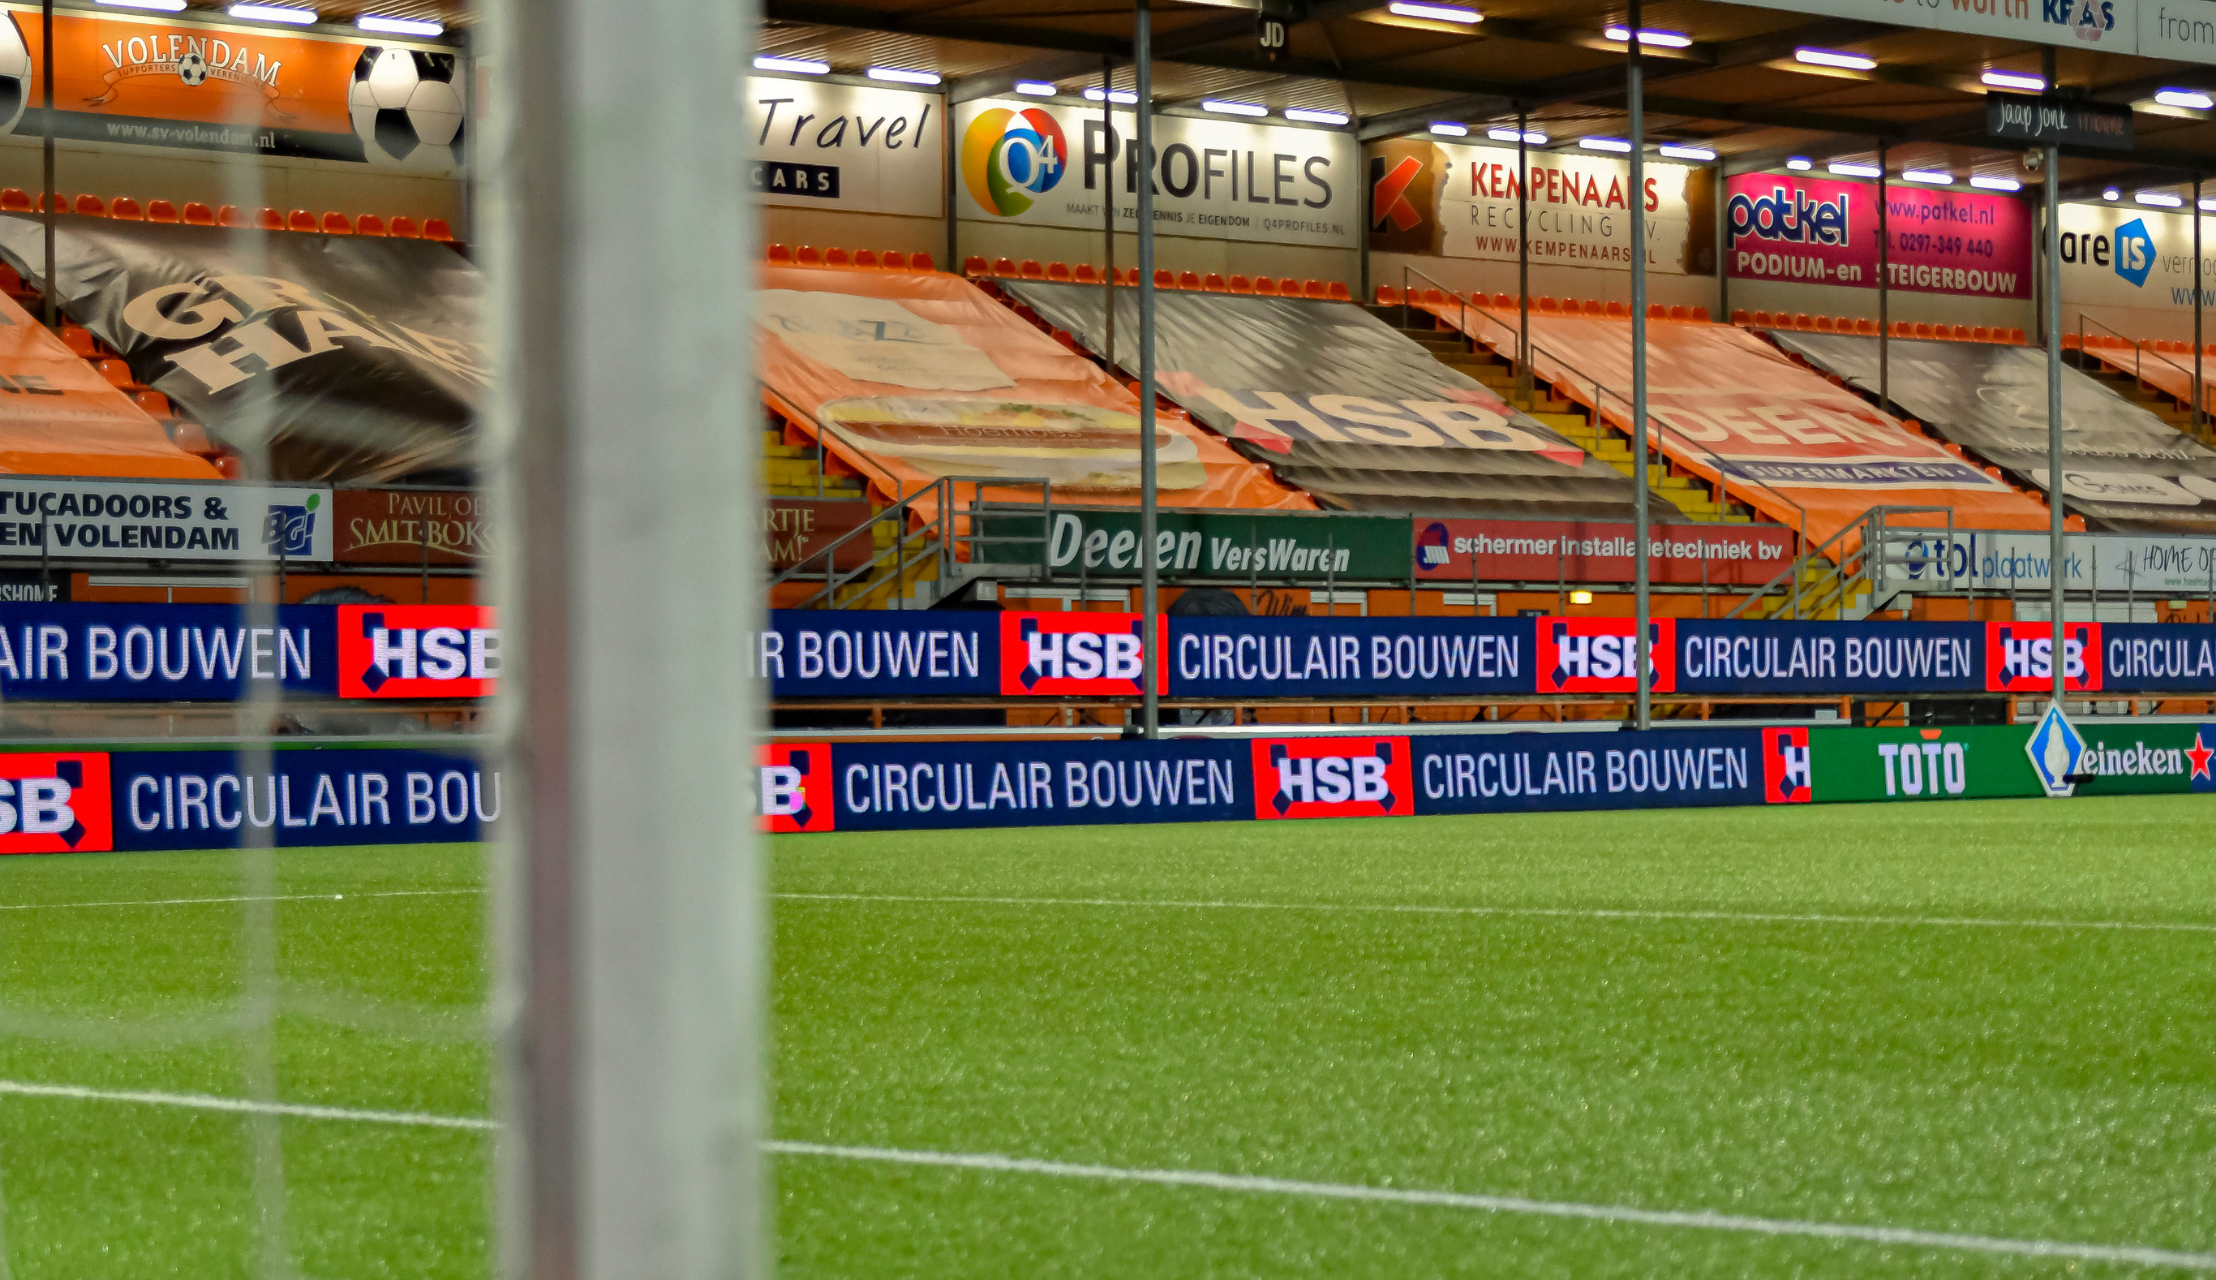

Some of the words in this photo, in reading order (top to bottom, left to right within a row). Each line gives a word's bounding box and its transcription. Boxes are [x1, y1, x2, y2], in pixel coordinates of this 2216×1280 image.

[1260, 22, 1284, 47] JD
[2159, 7, 2215, 44] from
[103, 34, 282, 87] VOLENDAM
[117, 63, 176, 78] SUPPORTERS
[210, 66, 267, 91] VERENIGNG
[107, 123, 276, 149] www.sv-volendam.nl
[759, 98, 931, 149] Travel
[999, 134, 1059, 195] Q4
[1083, 119, 1333, 209] PROFILES
[1199, 212, 1250, 227] EIGENDOM
[1738, 252, 1862, 282] PODIUM-en
[1967, 239, 1994, 258] 440
[2042, 225, 2111, 267] are
[1200, 389, 1546, 452] HSB
[1650, 402, 1907, 448] DEEN
[1745, 462, 1952, 482] SUPERMARKTEN
[203, 496, 229, 521] &
[54, 523, 240, 551] VOLENDAM
[1454, 534, 1557, 556] schermer
[1561, 536, 1752, 561] installaietechniek
[1758, 540, 1783, 561] bv
[1982, 549, 2082, 587] plaatwrk
[88, 625, 312, 681] BOUWEN
[799, 629, 979, 680] BOUWEN
[1028, 632, 1143, 681] HSB
[1179, 633, 1360, 681] CIRCULAIR
[1371, 634, 1519, 680] BOUWEN
[1558, 635, 1655, 679] HSB
[1685, 636, 1837, 679] CIRCULAIR
[1845, 636, 1972, 679] BOUWEN
[2004, 637, 2086, 679] HSB
[2108, 637, 2215, 679] CIRCULA
[1278, 756, 1391, 803] HSB
[1423, 750, 1598, 799] CIRCULAIR
[1606, 746, 1749, 793] BOUWEN
[1878, 741, 1967, 796] TOTO
[2082, 741, 2184, 776] eineken
[130, 771, 392, 831] CIRCULAIR
[845, 762, 1055, 814] CIRCULAIR
[1065, 759, 1235, 809] BOUWEN
